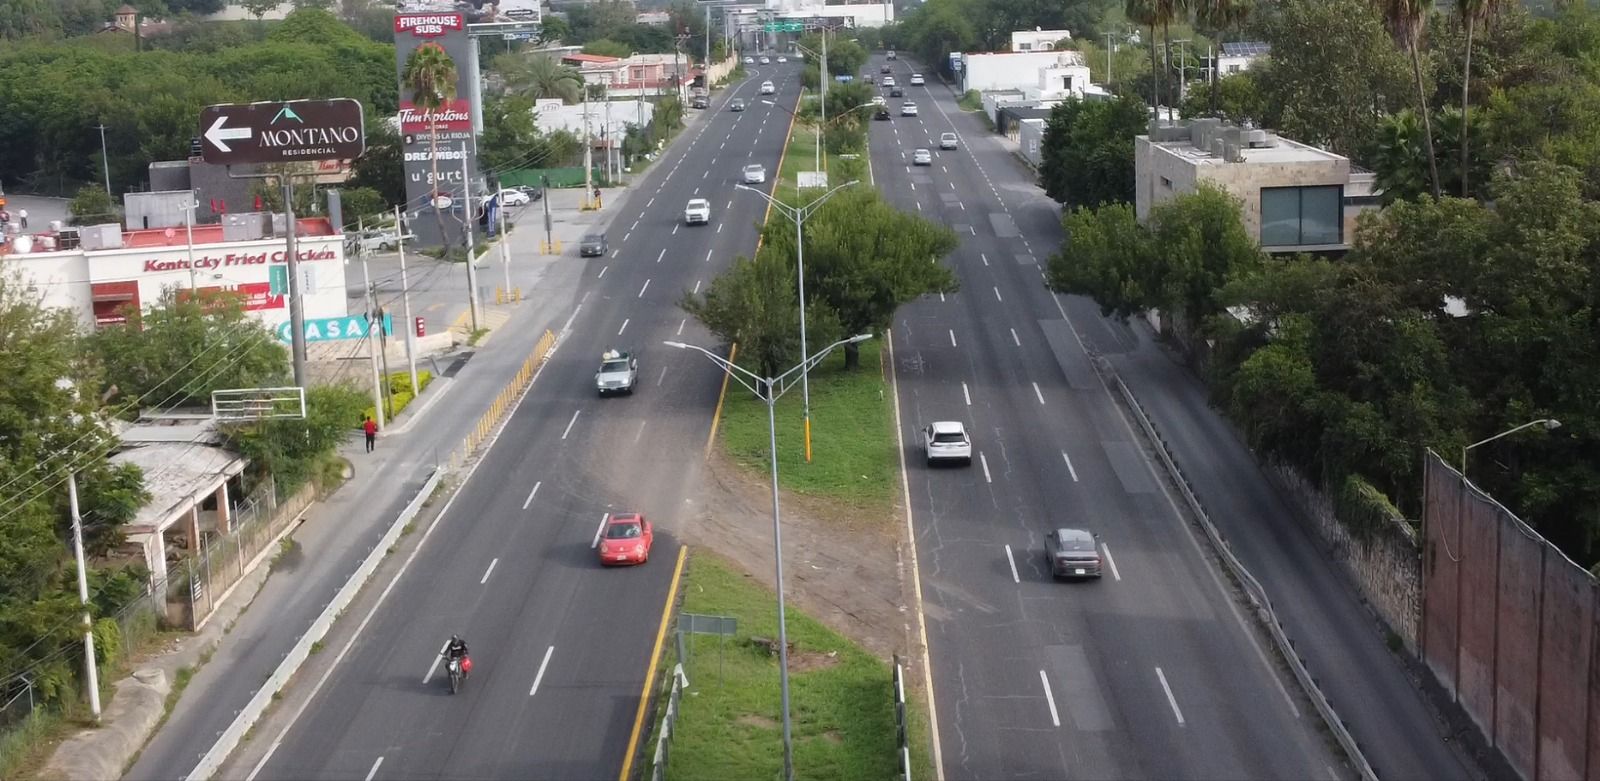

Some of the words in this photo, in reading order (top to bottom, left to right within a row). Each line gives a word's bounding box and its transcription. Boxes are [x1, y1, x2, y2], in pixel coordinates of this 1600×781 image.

[400, 16, 457, 28] FIREHOUSE
[416, 25, 442, 34] SUBS
[400, 108, 421, 123] Tim
[259, 126, 358, 148] MONTANO
[282, 147, 336, 156] RESIDENCIAL
[143, 255, 222, 271] Kentucky
[225, 253, 267, 267] Fried
